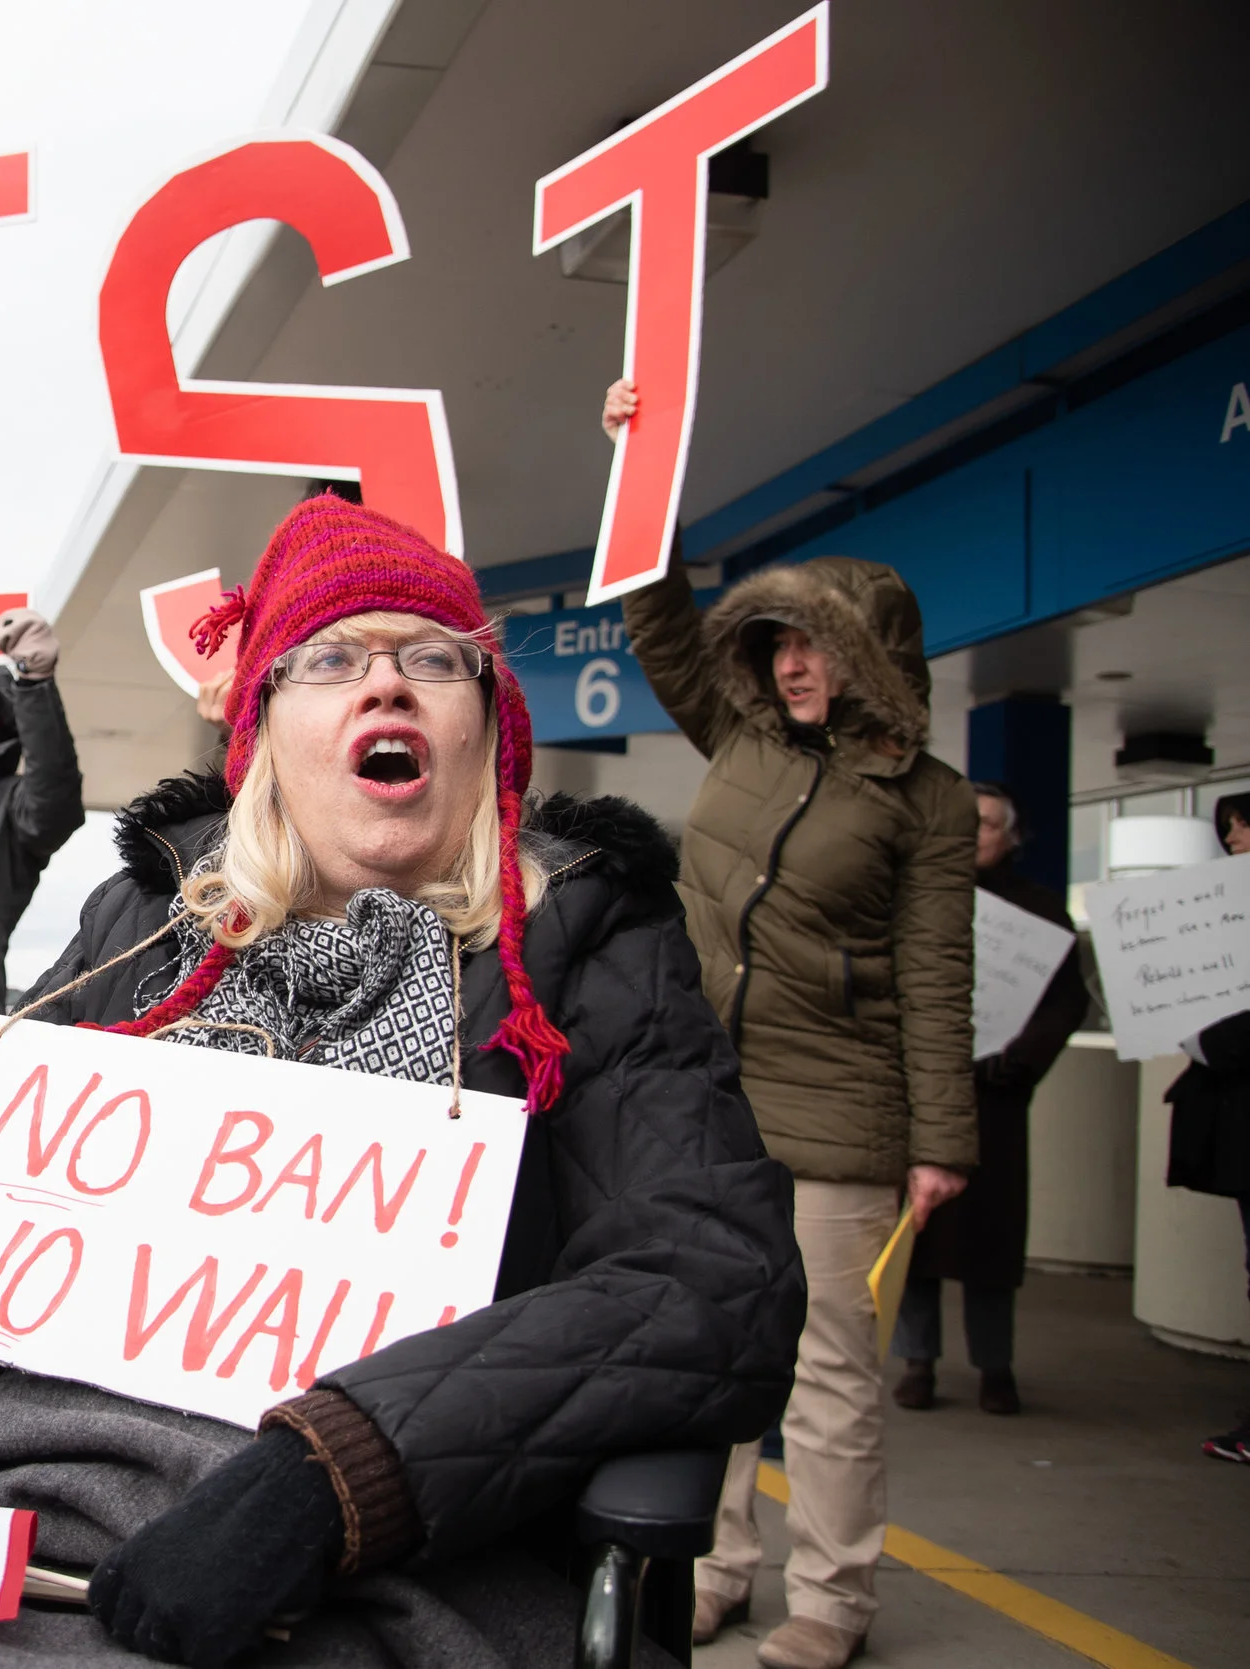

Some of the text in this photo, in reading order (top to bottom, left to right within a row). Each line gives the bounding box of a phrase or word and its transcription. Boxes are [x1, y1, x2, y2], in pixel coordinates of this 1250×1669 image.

[553, 618, 634, 657] Entr
[575, 657, 621, 728] 6
[188, 1110, 486, 1248] BAN!
[123, 1243, 457, 1392] WAL
